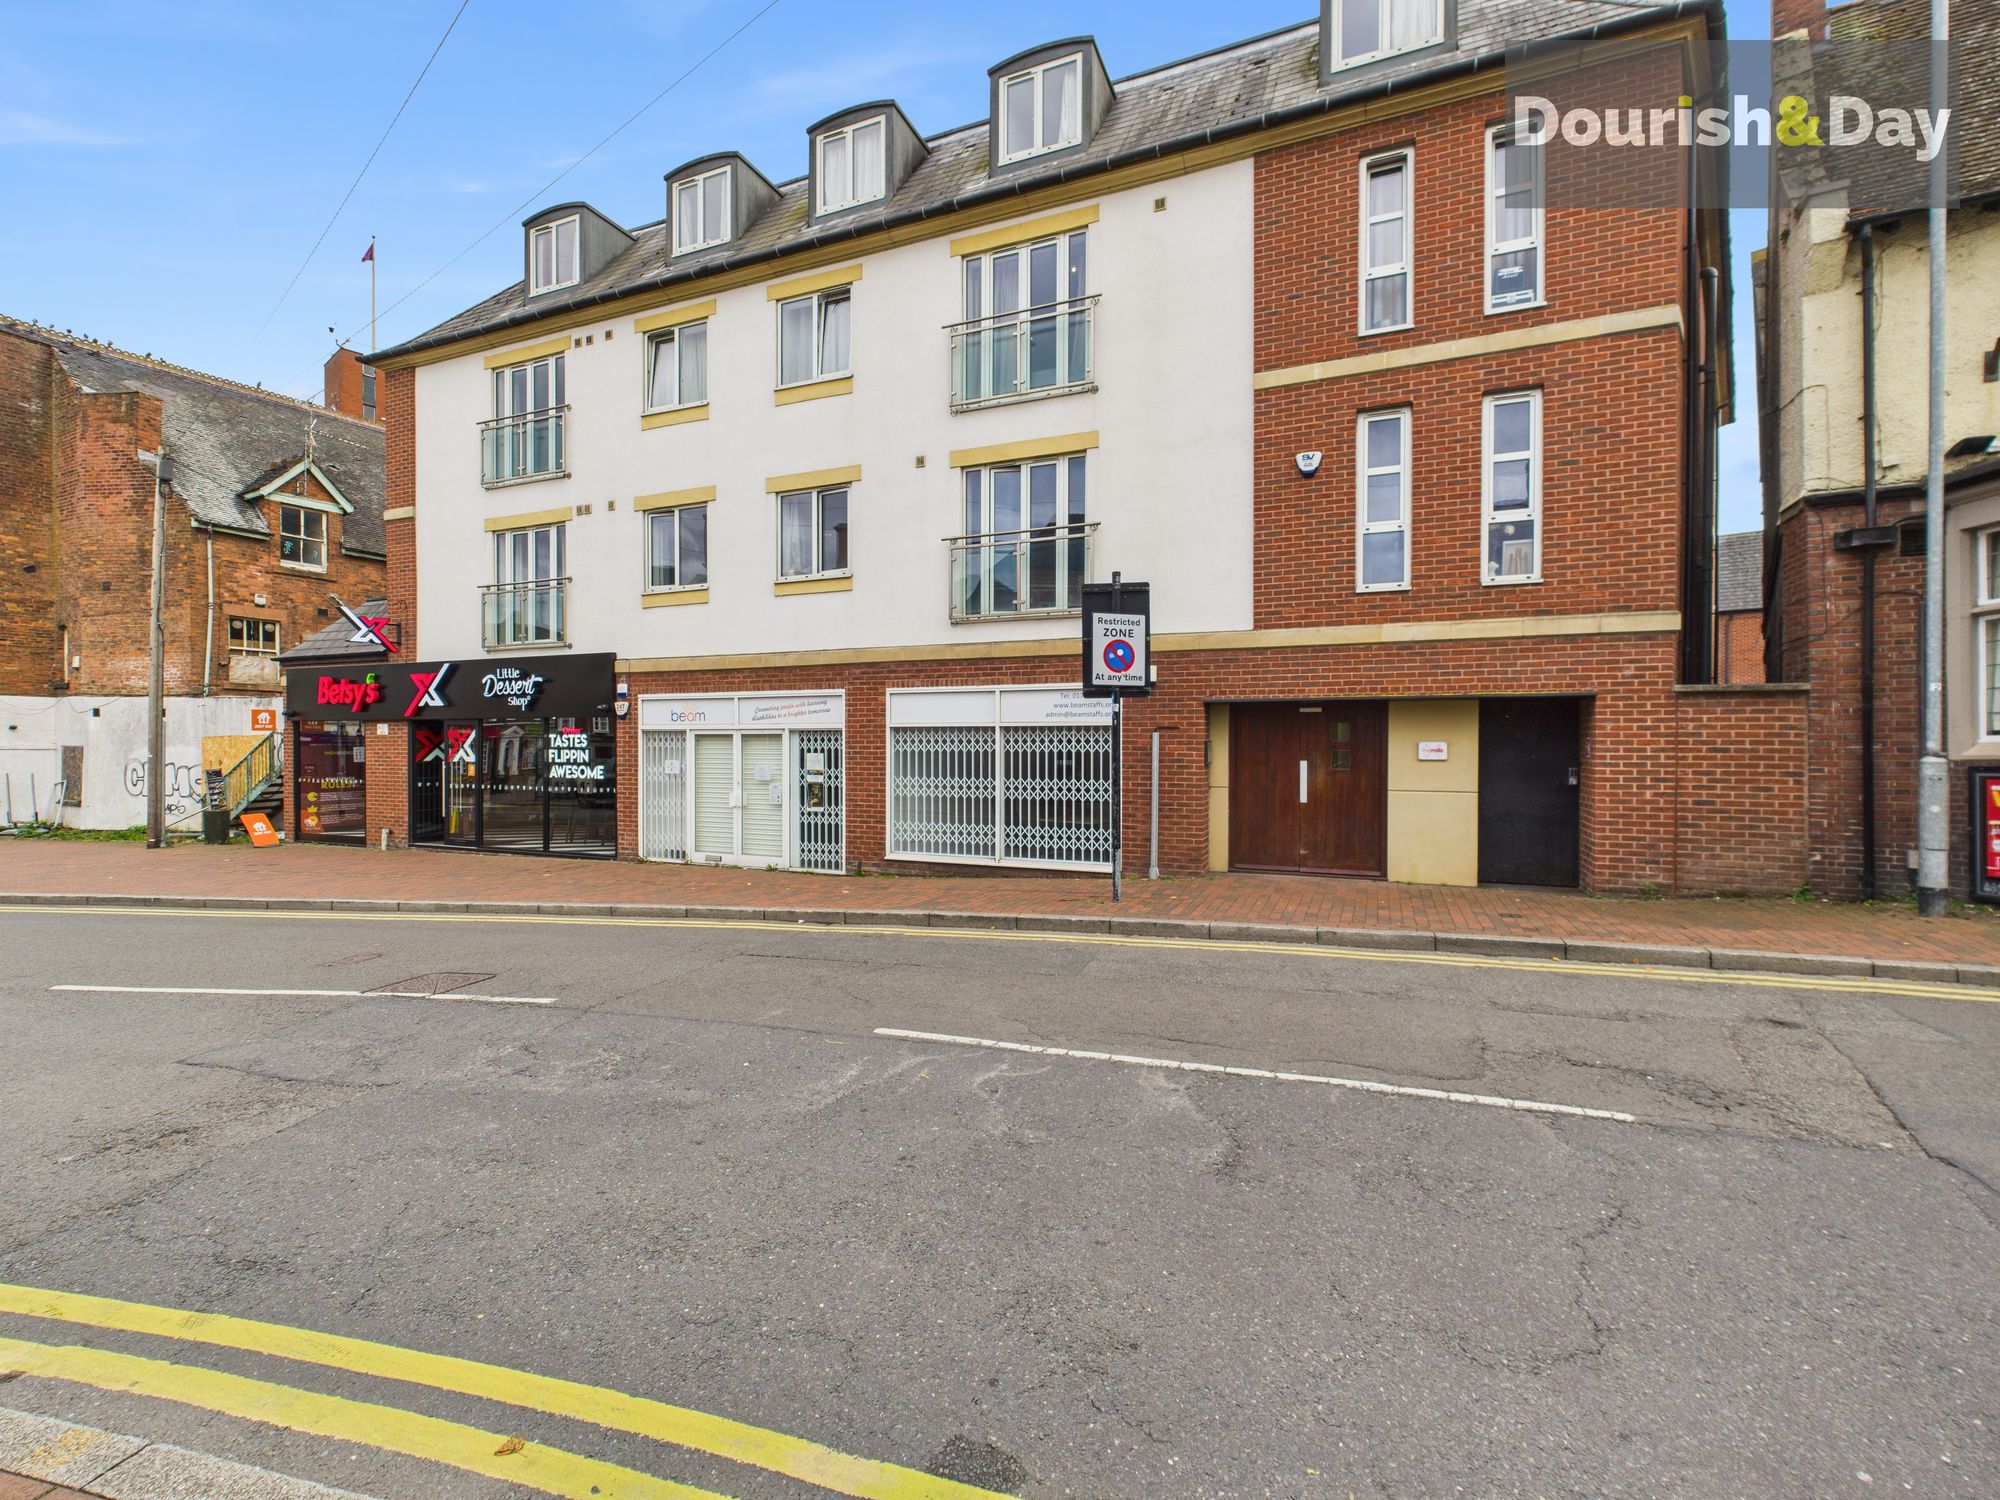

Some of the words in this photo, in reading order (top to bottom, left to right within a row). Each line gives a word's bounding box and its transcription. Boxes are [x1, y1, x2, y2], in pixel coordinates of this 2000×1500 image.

[1097, 617, 1141, 627] Restricted
[1103, 628, 1134, 638] ZONE
[496, 668, 520, 679] Little
[1095, 673, 1105, 681] At
[1107, 675, 1122, 683] any
[1124, 674, 1143, 682] time
[482, 674, 542, 697] Dessert
[317, 673, 381, 713] Betsy's
[508, 696, 528, 711] Shop
[671, 710, 706, 722] beam
[549, 734, 588, 748] TASTES
[548, 749, 589, 763] FLIPPIN
[549, 765, 604, 779] AWESOME
